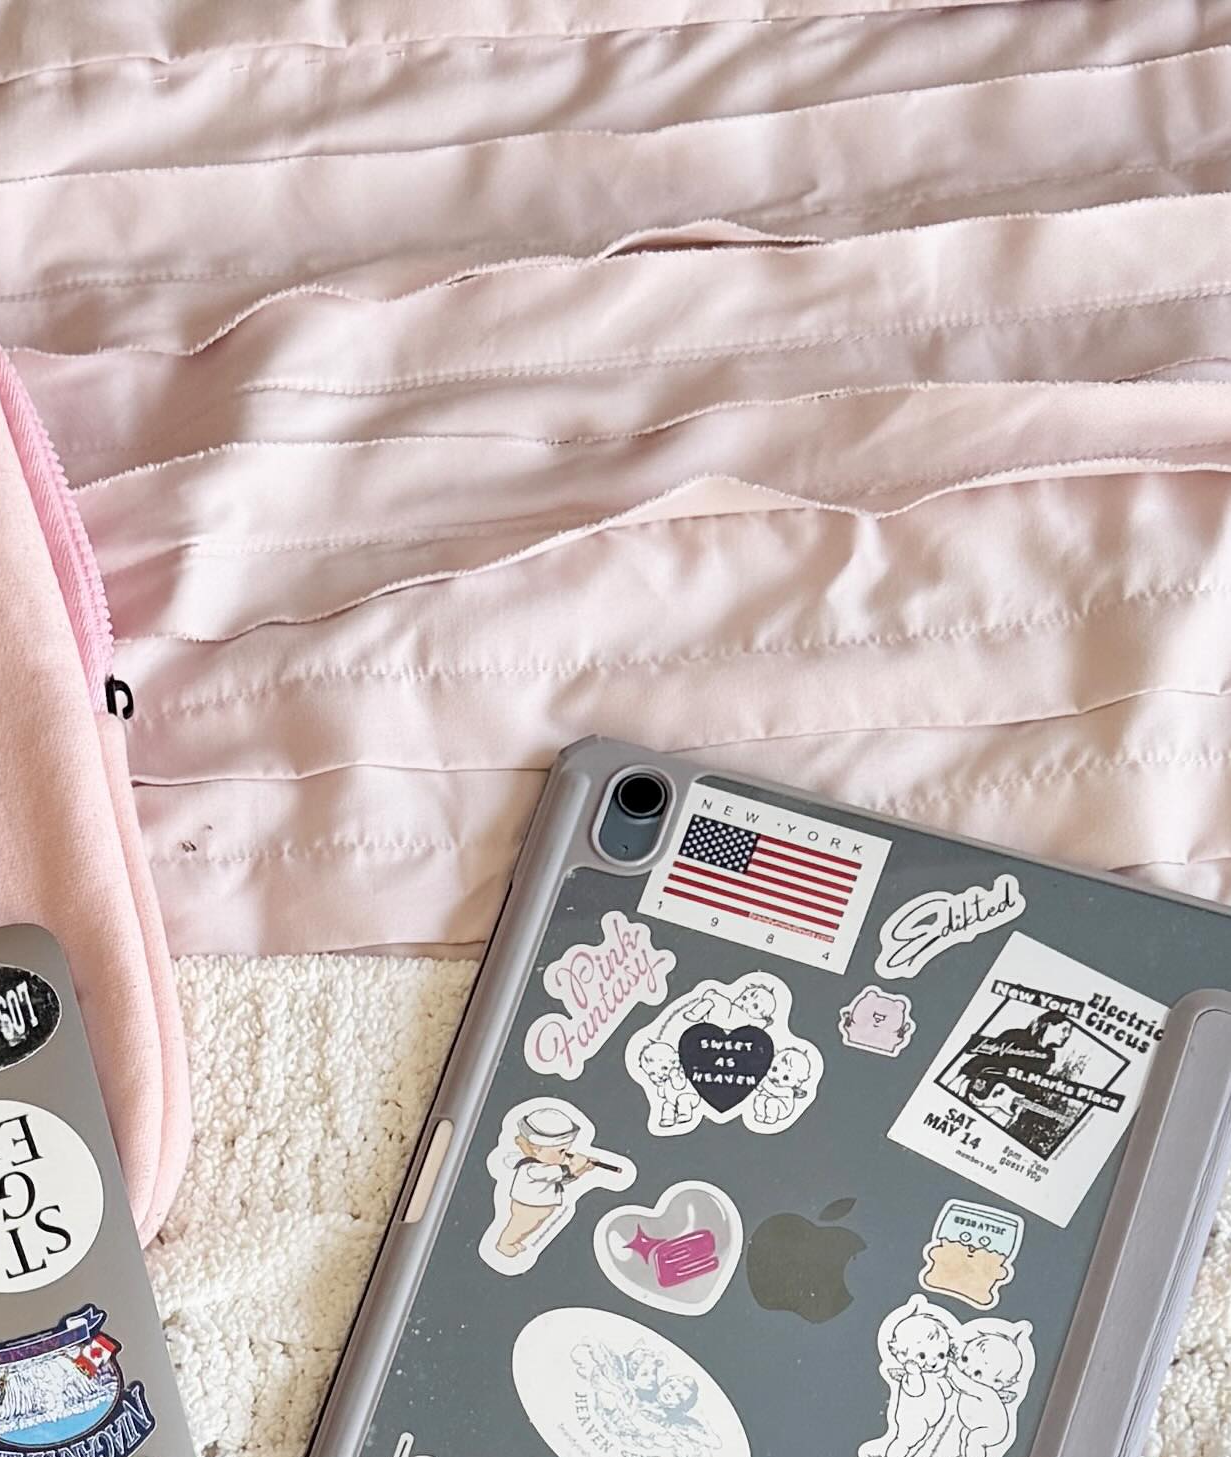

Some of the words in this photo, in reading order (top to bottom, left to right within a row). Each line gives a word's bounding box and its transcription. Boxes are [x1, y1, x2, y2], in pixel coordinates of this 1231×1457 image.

[701, 798, 759, 824] NEW
[787, 823, 863, 854] YORK
[555, 919, 640, 1009] Pink
[994, 982, 1035, 1006] New
[1040, 994, 1082, 1018] York
[1085, 992, 1165, 1042] Electric
[700, 1038, 755, 1052] SWEET
[1084, 1011, 1151, 1054] Circus
[692, 1072, 757, 1086] HEAVEN
[714, 1056, 736, 1068] AS
[1075, 1086, 1120, 1109] Place
[923, 1112, 955, 1138] MAY
[959, 1129, 983, 1150] 14
[944, 1107, 977, 1130] SAT
